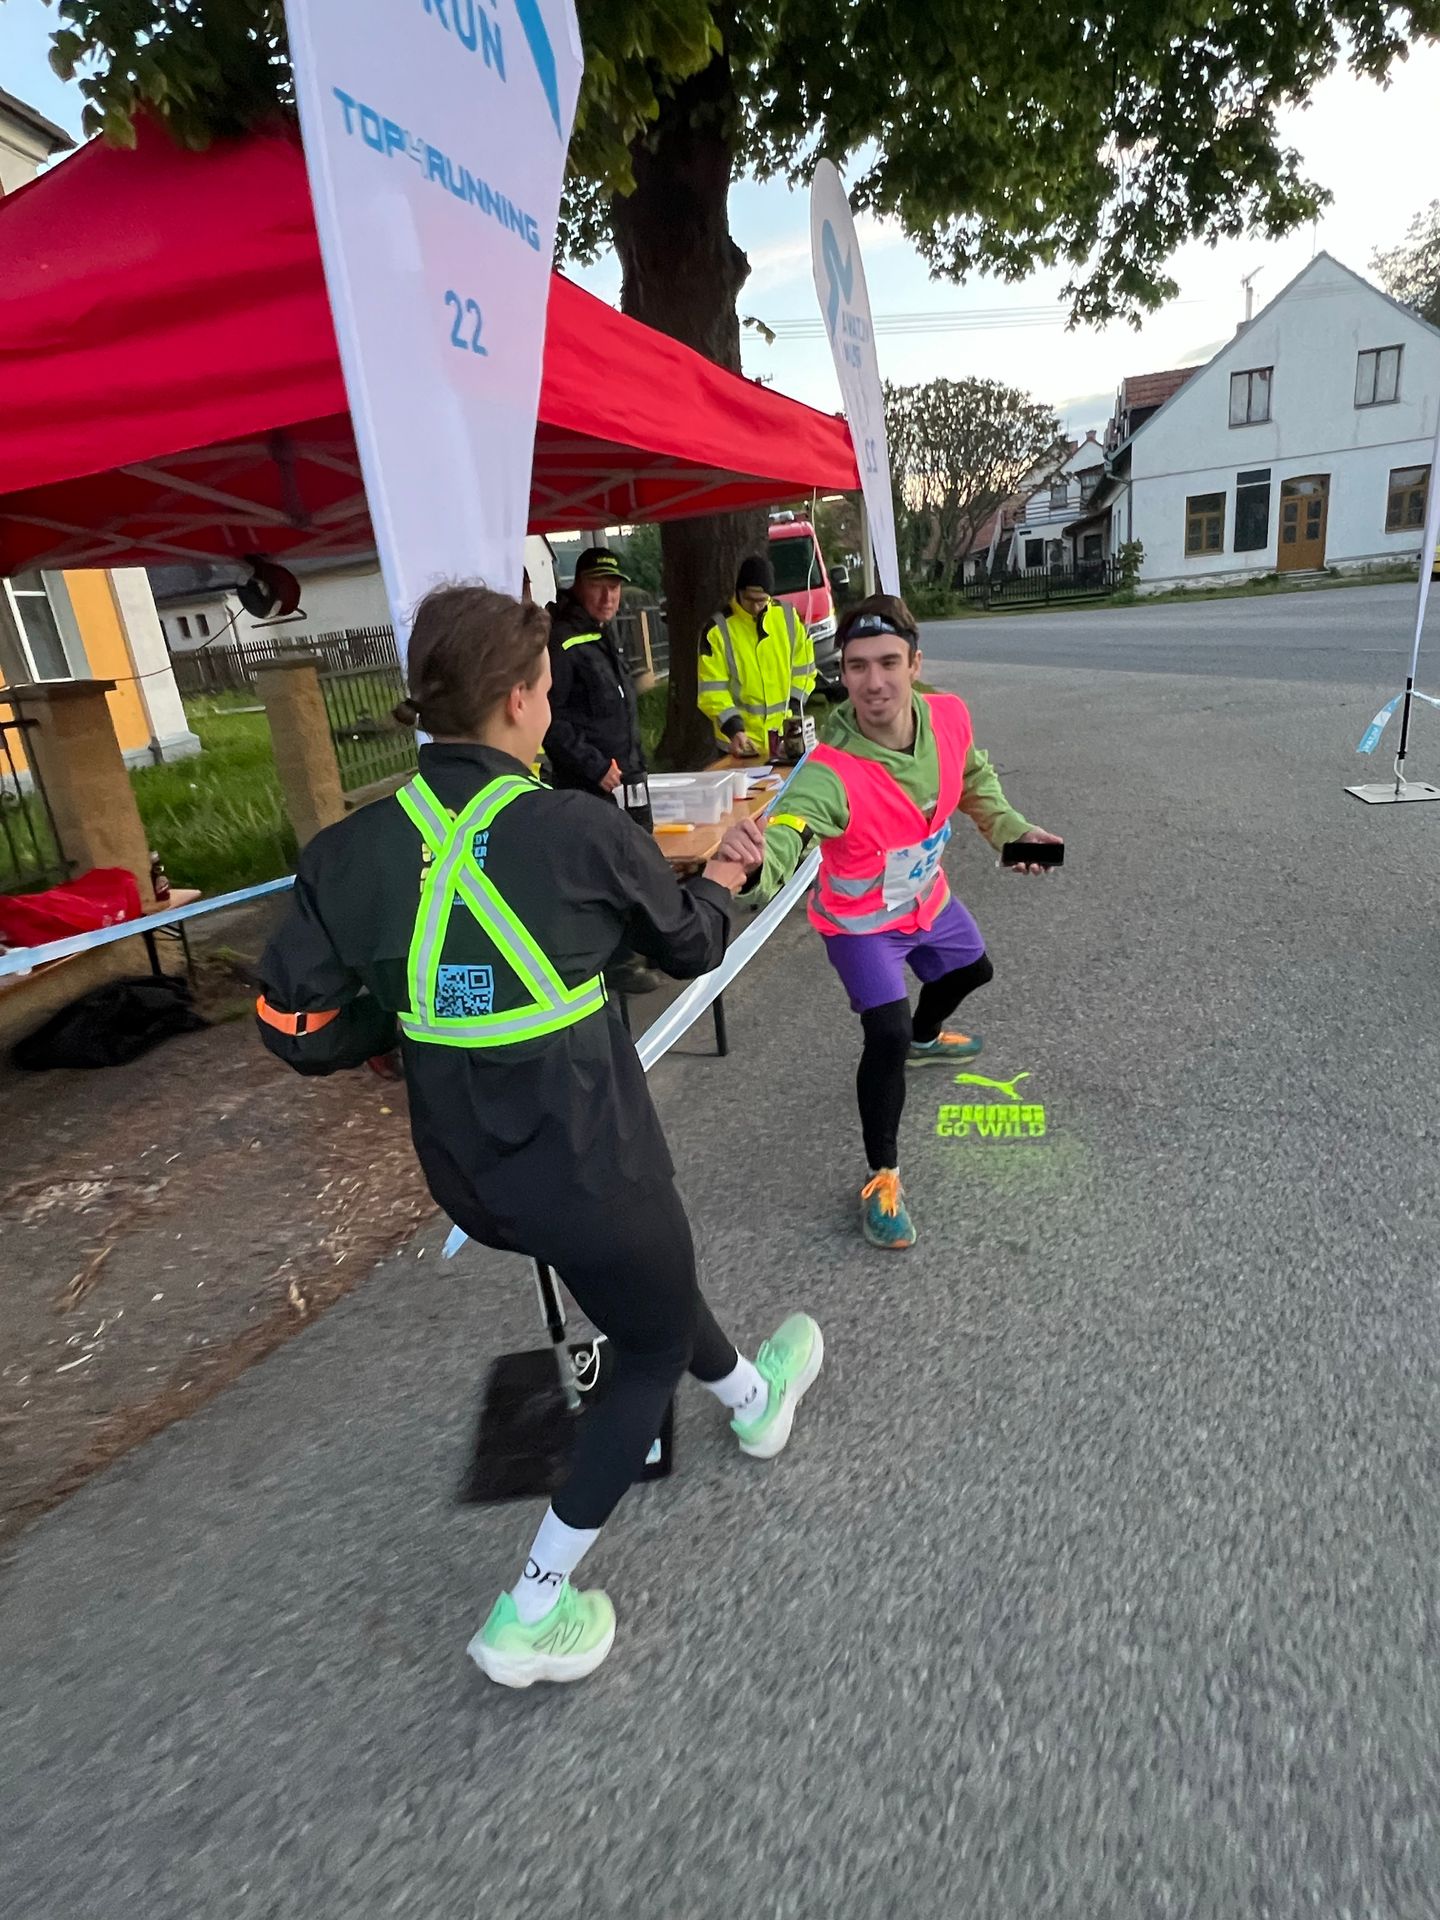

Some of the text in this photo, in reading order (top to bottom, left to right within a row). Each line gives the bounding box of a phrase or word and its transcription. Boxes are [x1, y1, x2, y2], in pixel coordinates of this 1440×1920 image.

[444, 290, 488, 356] 22
[936, 1121, 1046, 1138] GO WILD
